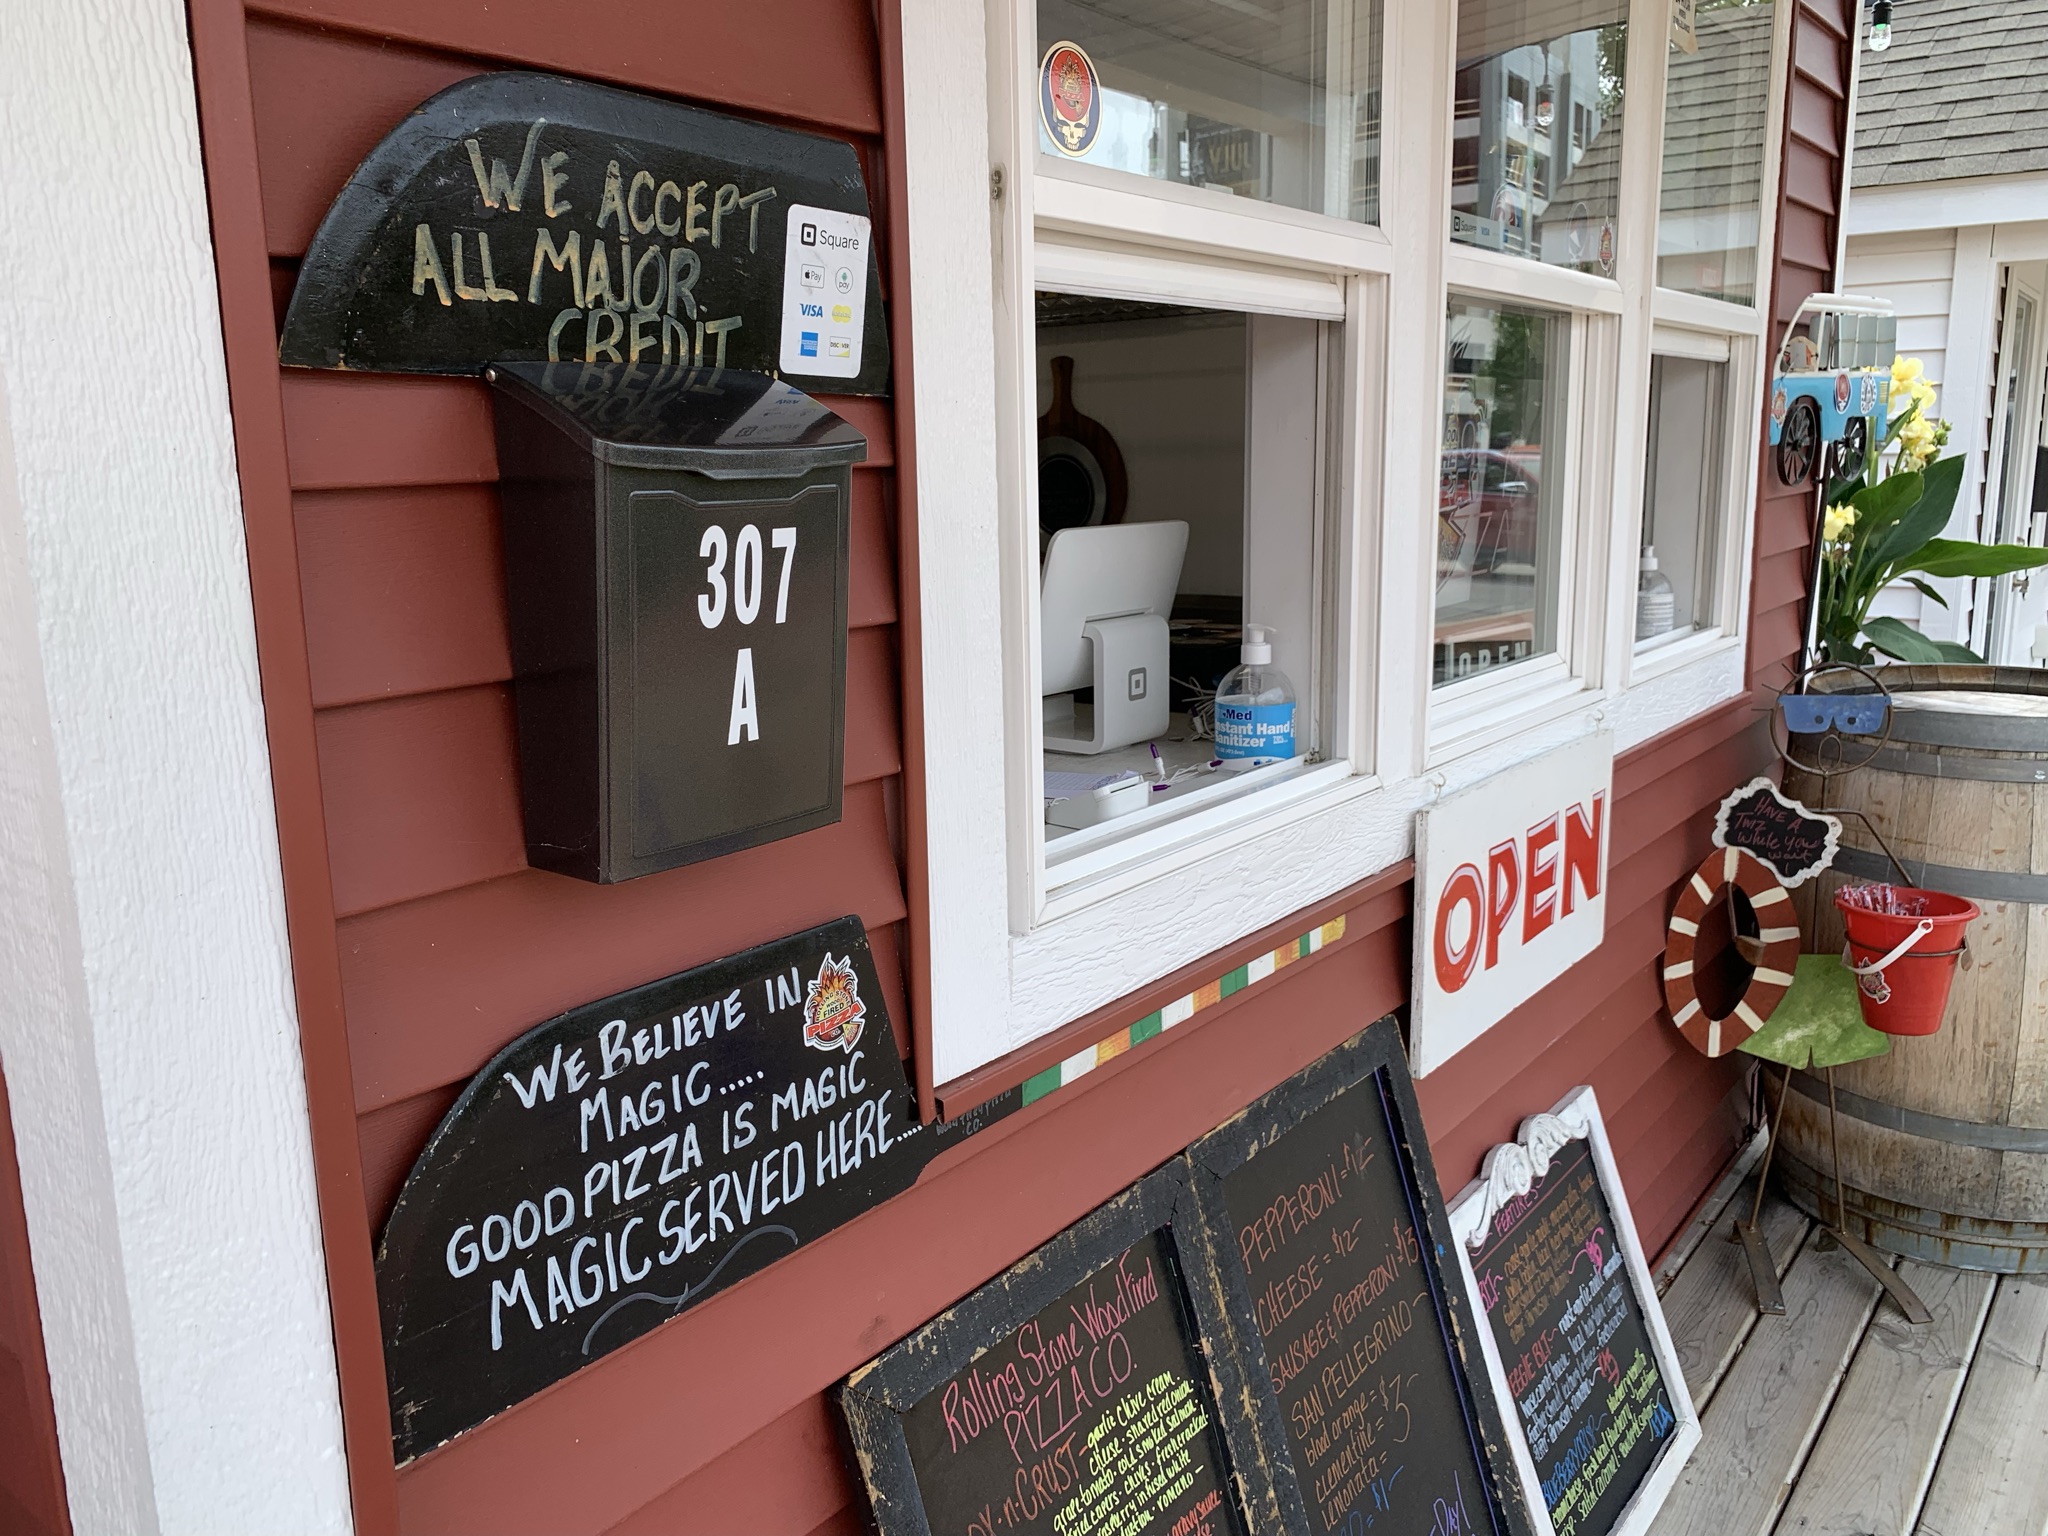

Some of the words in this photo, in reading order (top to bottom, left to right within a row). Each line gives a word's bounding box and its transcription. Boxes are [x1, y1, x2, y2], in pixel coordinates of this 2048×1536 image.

[465, 117, 573, 219] WE
[596, 160, 777, 254] ACCEPT
[411, 223, 519, 307] ALL
[811, 271, 822, 283] Pay
[820, 229, 859, 250] Square
[800, 303, 823, 318] VISA
[698, 524, 797, 629] 307
[728, 647, 759, 745] A
[1257, 721, 1290, 735] Hand
[1433, 789, 1606, 994] OPEN
[503, 1044, 591, 1109] WE
[598, 988, 746, 1080] BELIEVE
[766, 967, 801, 1015] IN
[807, 1002, 862, 1039] PIZZA
[823, 1002, 844, 1018] FIRED
[446, 1188, 574, 1278] GOOD
[583, 1122, 703, 1218] PIZZA
[722, 1102, 755, 1155] IS
[771, 1052, 865, 1132] MAGIC
[491, 1218, 651, 1351] MAGIC
[658, 1142, 806, 1265] SERVED
[1239, 1164, 1342, 1274] PEPPERONI
[1258, 1255, 1323, 1336] CHEESE
[1269, 1319, 1330, 1394] SAUSAGE
[1332, 1254, 1400, 1330] PEPPERONI
[941, 1362, 1025, 1453] Rolling
[1018, 1319, 1083, 1386] Stone
[1070, 1273, 1131, 1344] Wood
[1119, 1249, 1158, 1313] Fired
[1291, 1384, 1325, 1440] SAN
[1322, 1300, 1412, 1407] PELLEGRINO
[1508, 1353, 1536, 1397] EGGIE
[1305, 1422, 1331, 1467] blood
[1331, 1392, 1369, 1440] orange
